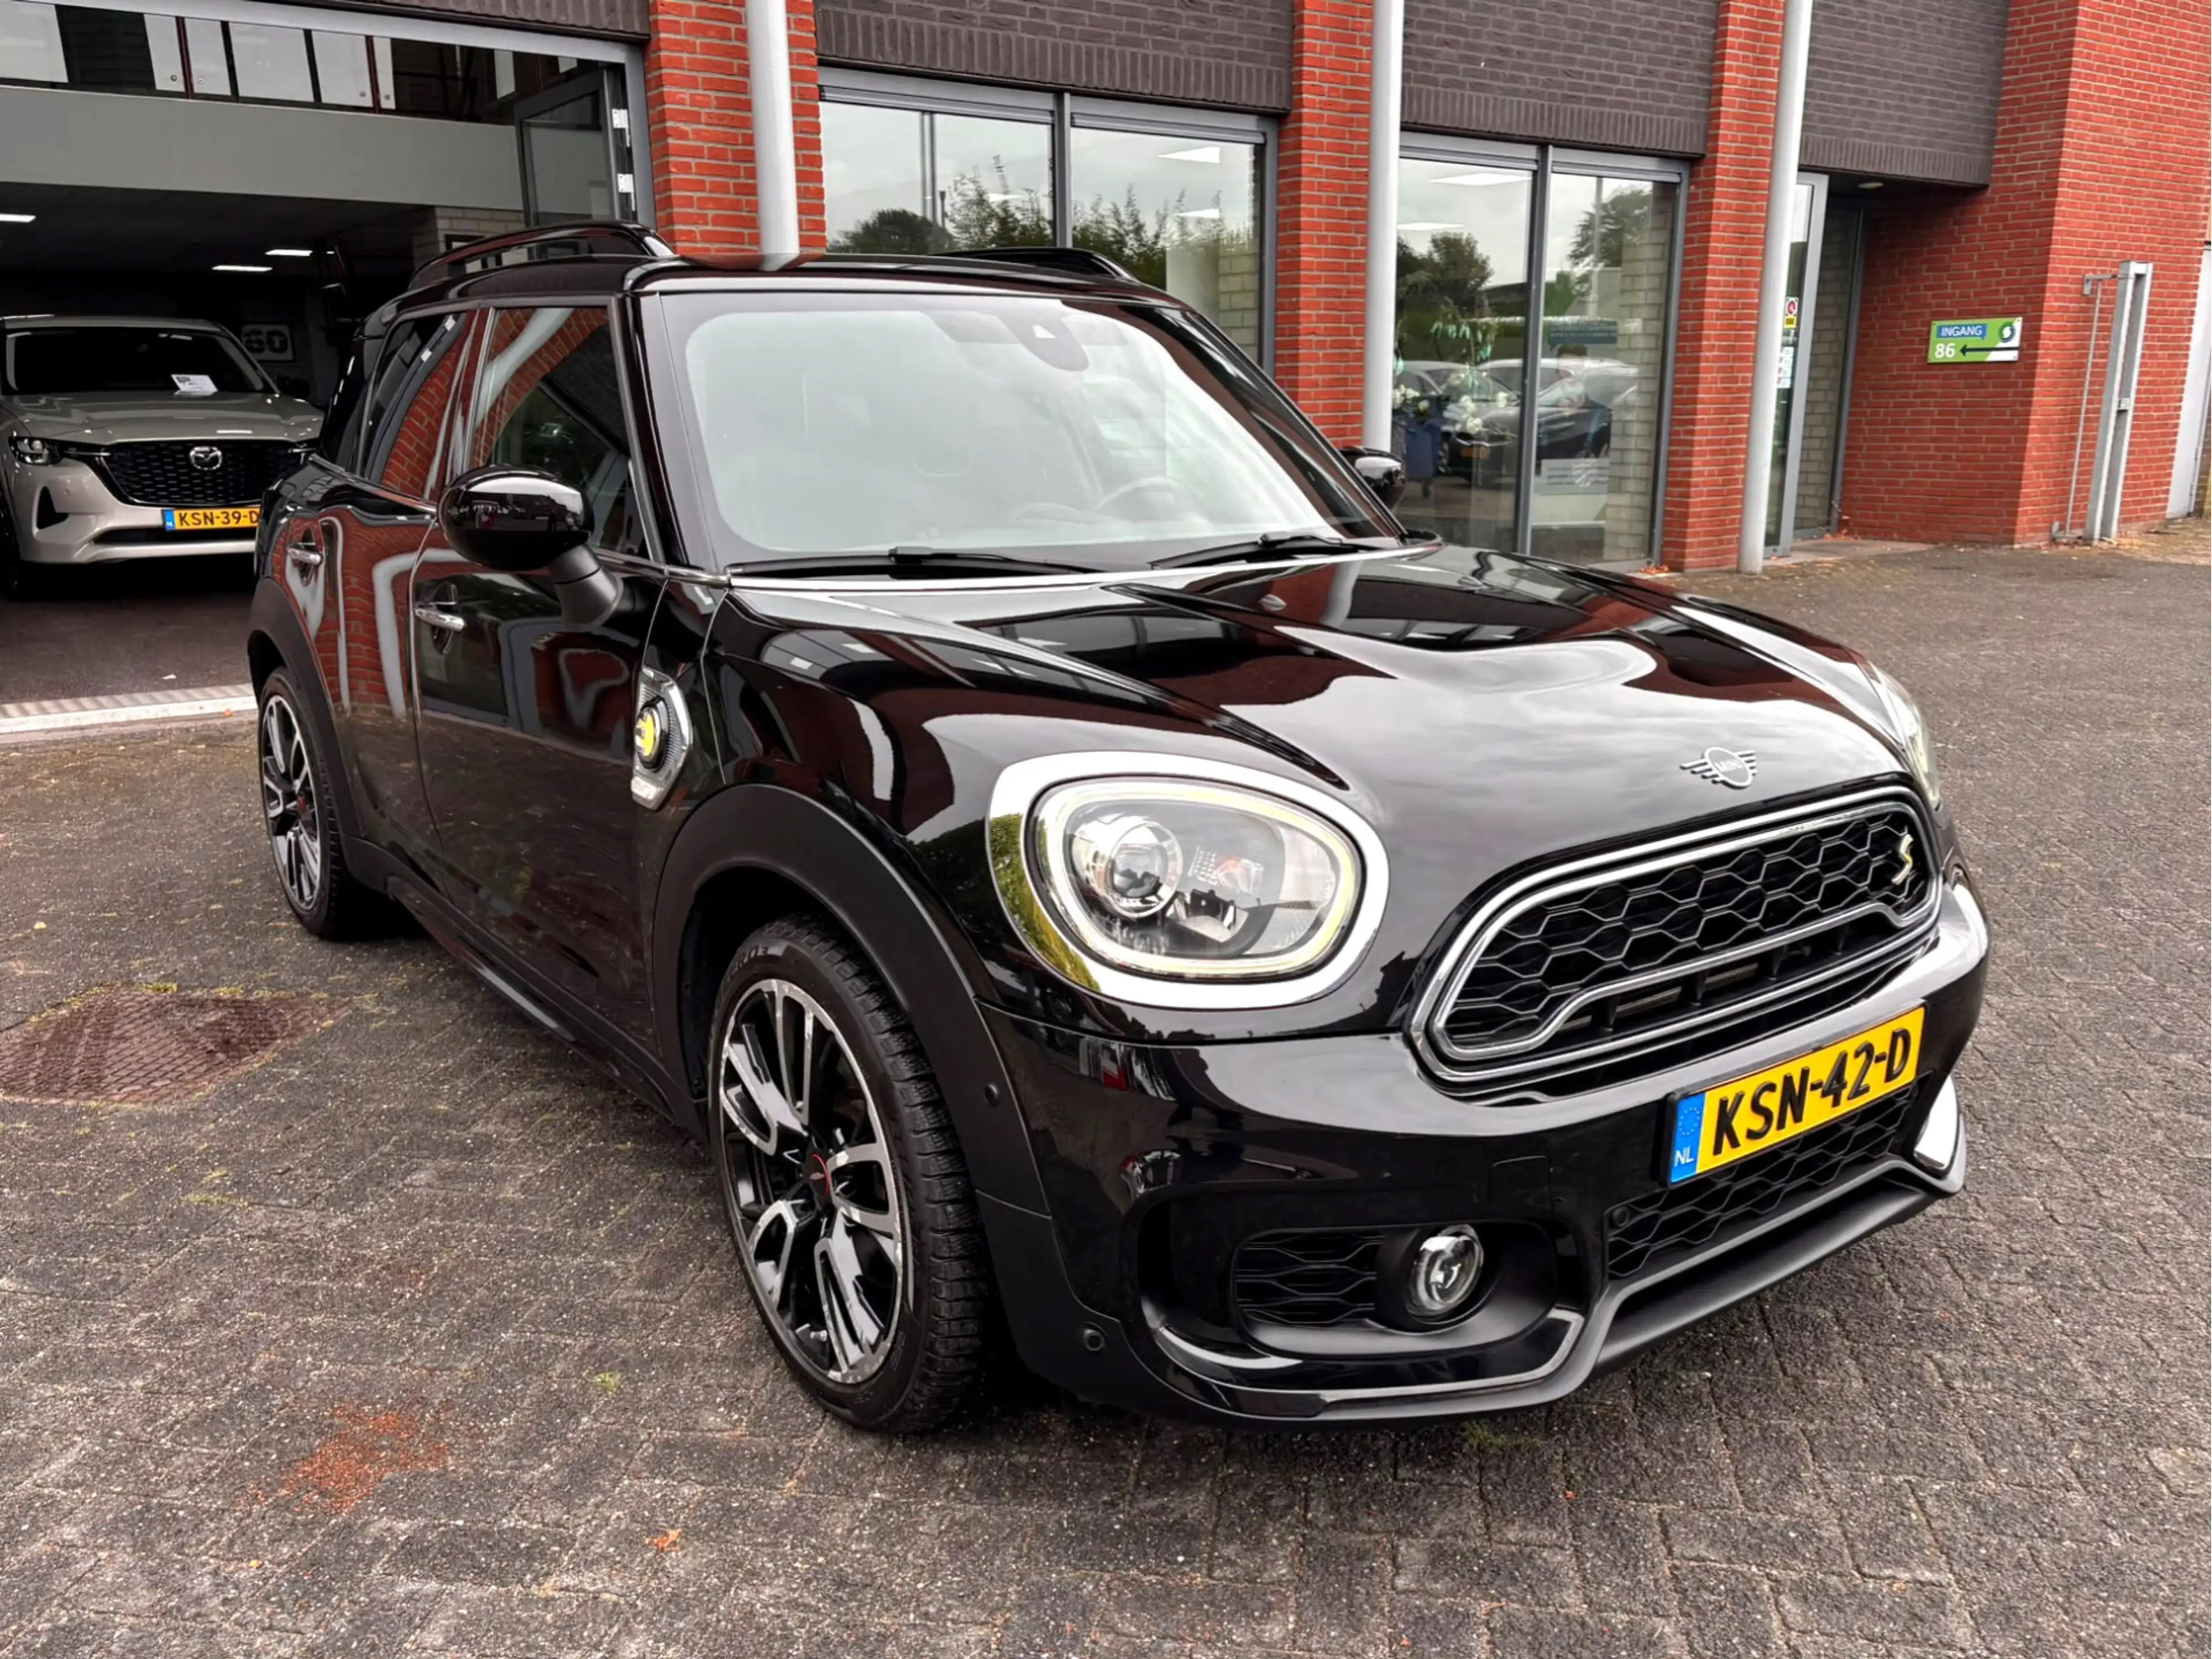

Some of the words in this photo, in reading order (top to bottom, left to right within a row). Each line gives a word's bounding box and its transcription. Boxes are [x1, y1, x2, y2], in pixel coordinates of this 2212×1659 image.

[1941, 325, 1983, 336] INGANG
[1935, 343, 1956, 358] 86
[179, 510, 260, 527] KSN-39-D
[1713, 1027, 1912, 1156] KSN-42-D
[1674, 1146, 1694, 1167] NL
